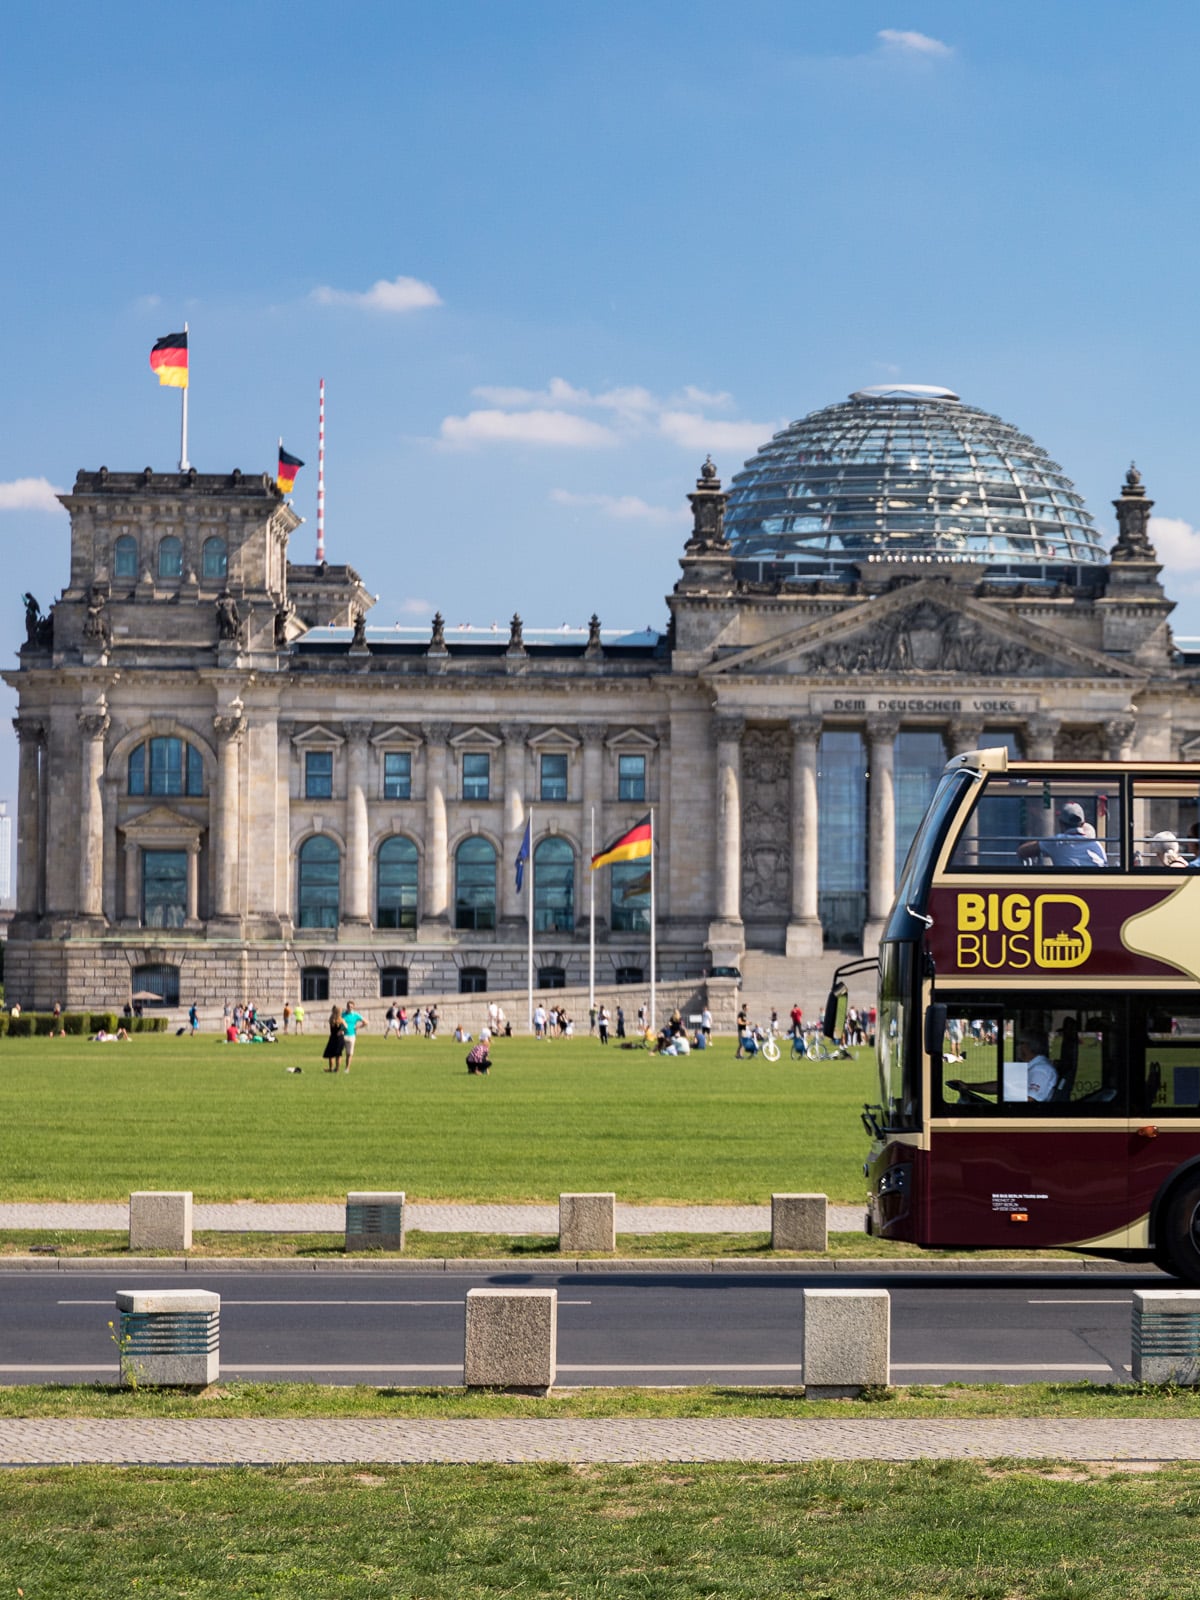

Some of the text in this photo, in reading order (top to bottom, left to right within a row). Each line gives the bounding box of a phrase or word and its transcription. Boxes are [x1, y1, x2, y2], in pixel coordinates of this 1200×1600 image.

[834, 699, 866, 710] DEM
[973, 701, 1017, 711] VOLKE
[957, 893, 1031, 932] BIG
[957, 934, 1031, 968] BUS
